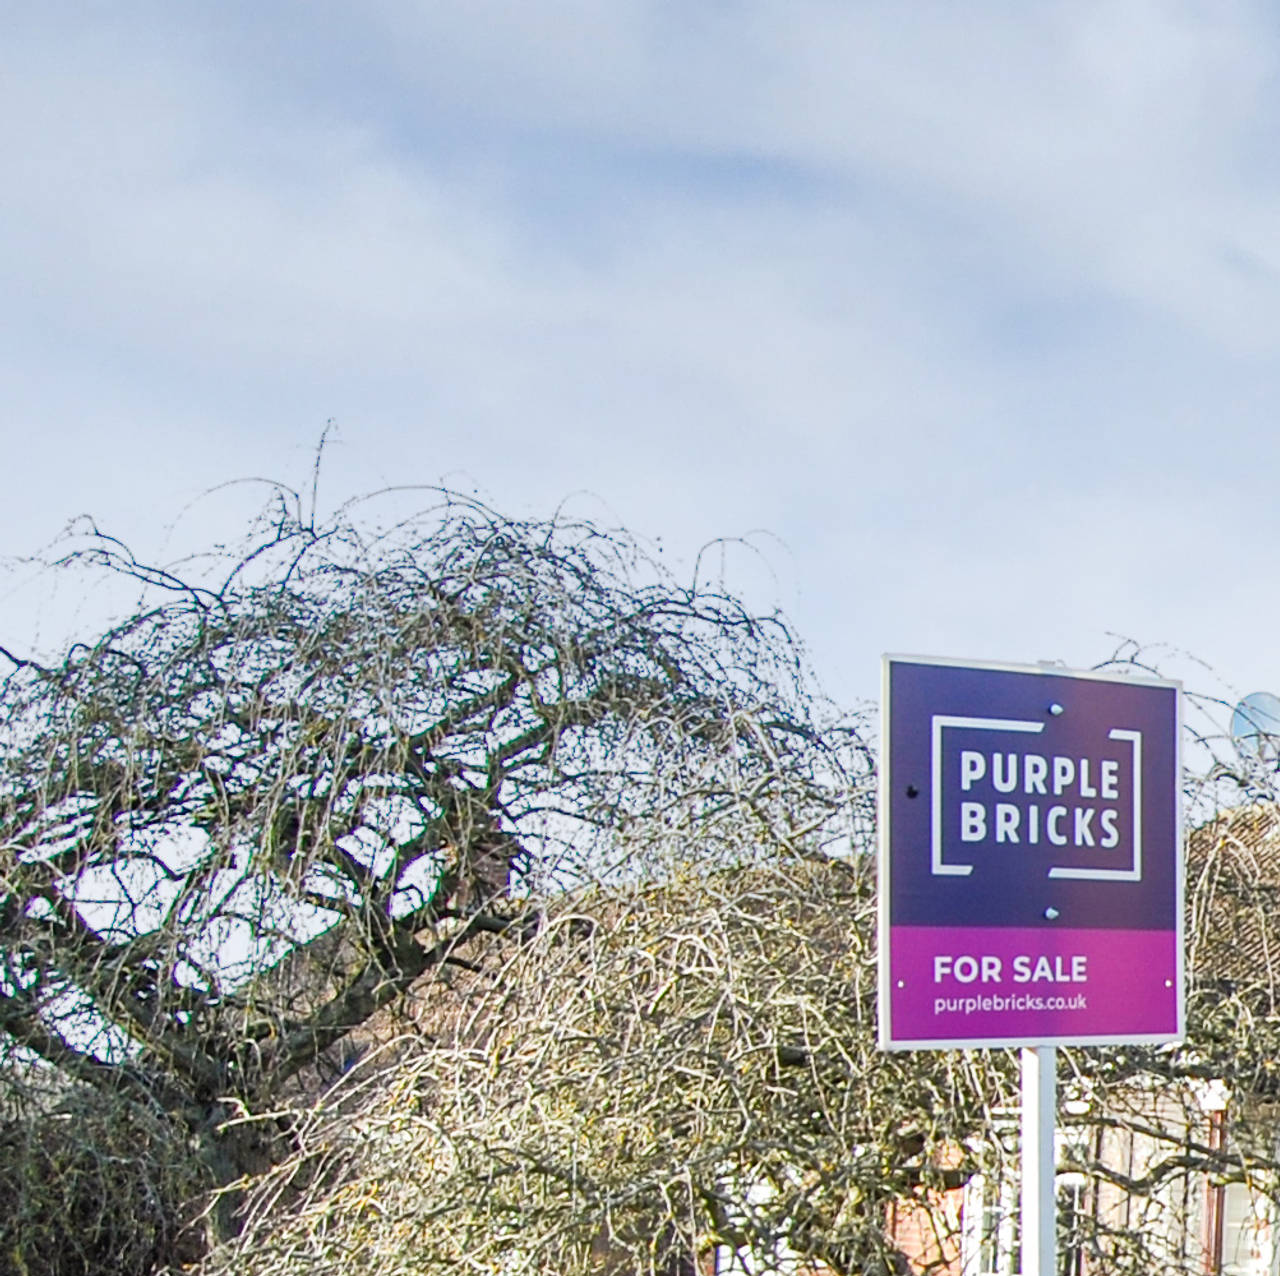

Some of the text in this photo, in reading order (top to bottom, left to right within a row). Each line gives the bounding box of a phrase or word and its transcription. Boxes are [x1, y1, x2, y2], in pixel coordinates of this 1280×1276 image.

[960, 750, 1120, 800] PURPLE
[960, 801, 1120, 849] BRICKS
[933, 955, 1088, 984] FOR SALE
[934, 993, 1088, 1015] purplebricks.co.uk
